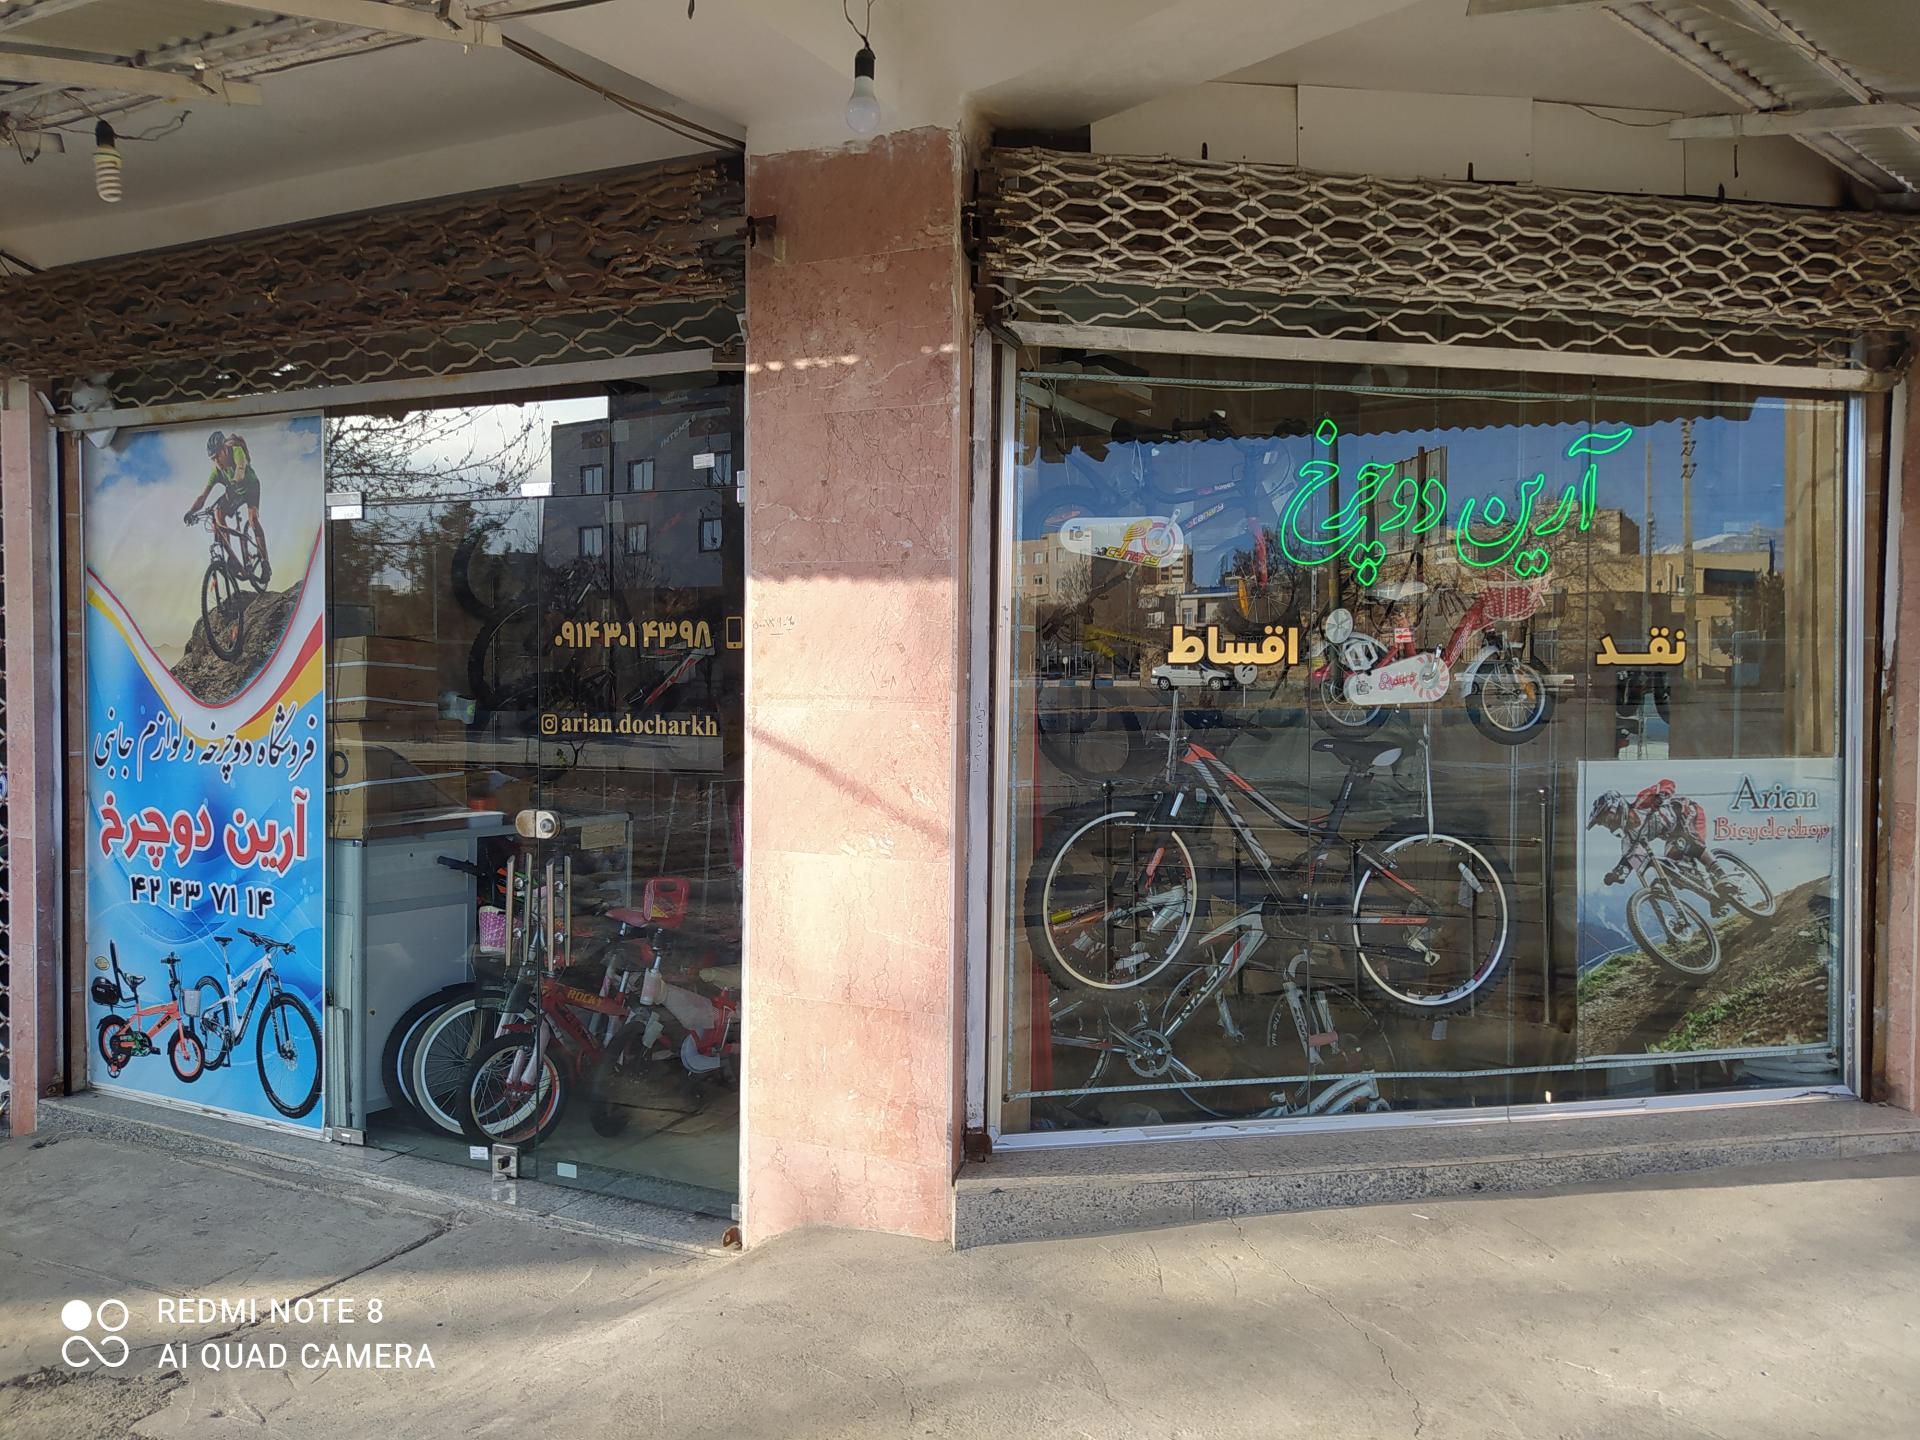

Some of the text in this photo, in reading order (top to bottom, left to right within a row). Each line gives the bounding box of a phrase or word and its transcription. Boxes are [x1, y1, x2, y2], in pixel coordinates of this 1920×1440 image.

[1456, 427, 1633, 577] آرین
[1167, 625, 1299, 665] اقساط
[1596, 627, 1686, 665] نقد
[94, 702, 318, 781] فروشگاه دوچرخه و لوازم جانبی
[561, 713, 718, 737] arian.docharkh
[1731, 775, 1818, 810] Arian
[100, 788, 309, 873] آرین دوچرخ
[1713, 815, 1830, 845] Bicycle shop
